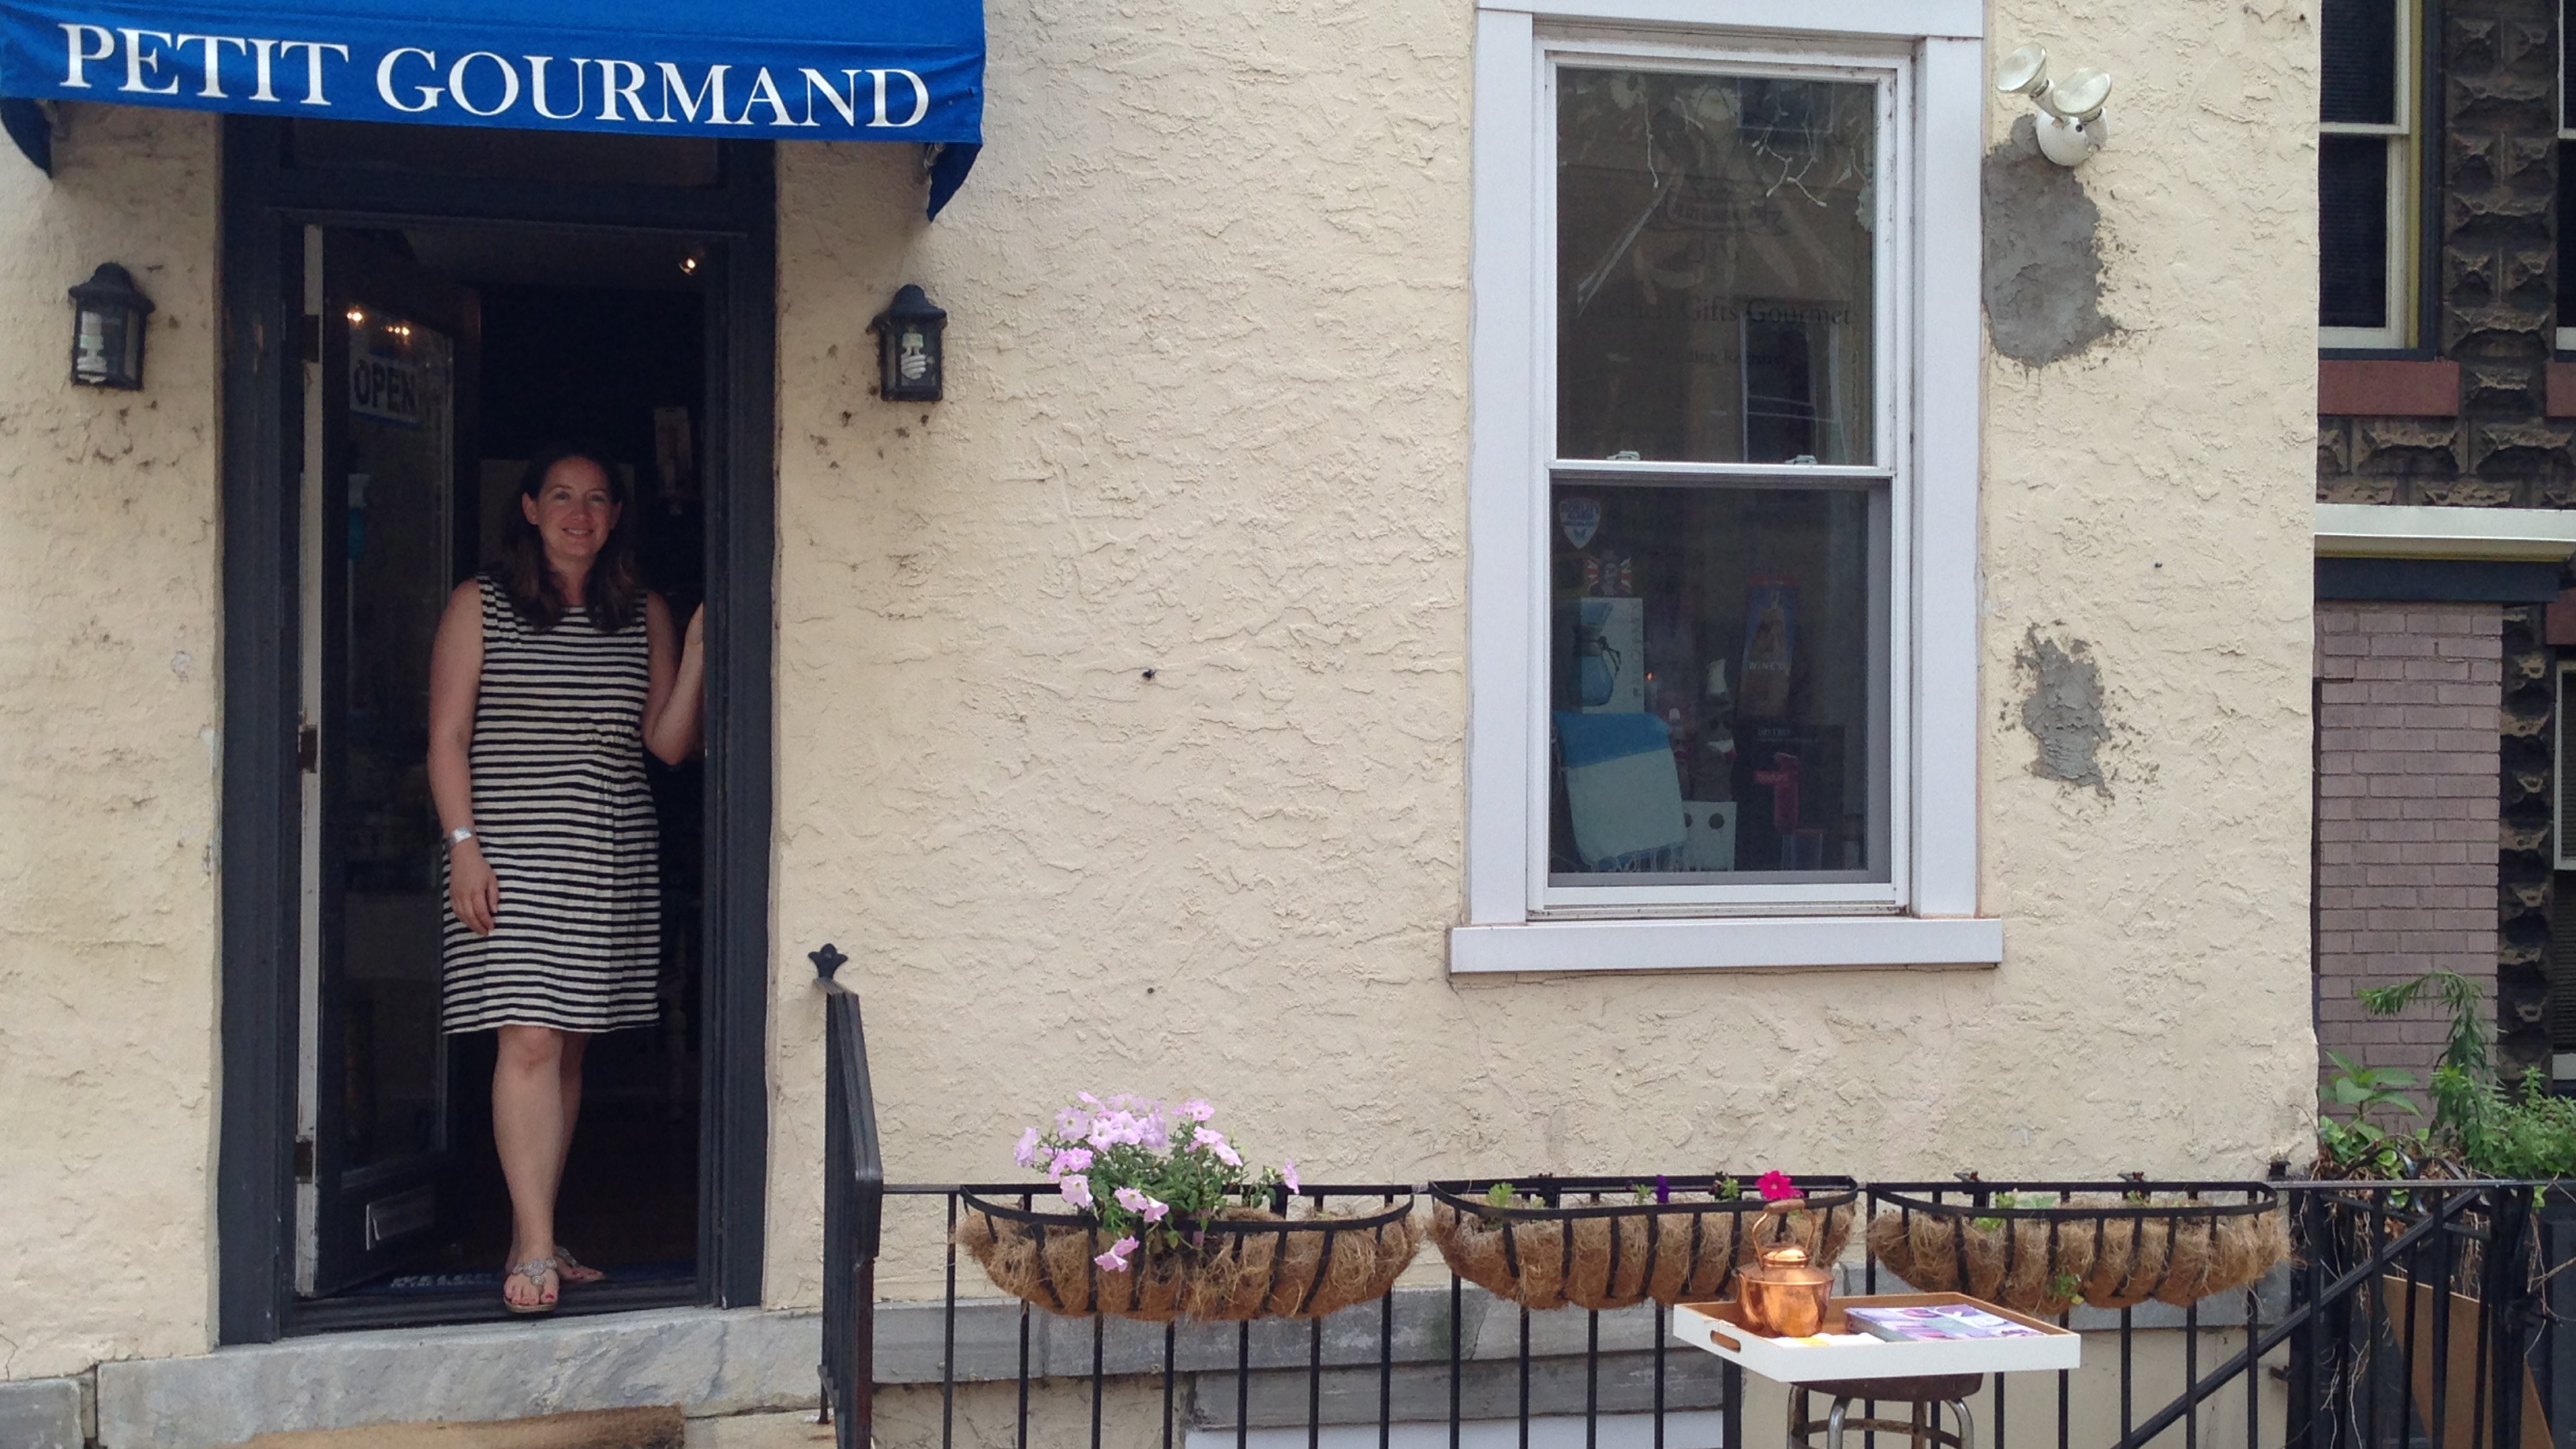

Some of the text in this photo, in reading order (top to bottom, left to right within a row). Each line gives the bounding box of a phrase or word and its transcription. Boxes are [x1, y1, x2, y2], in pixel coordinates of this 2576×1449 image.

[58, 21, 931, 129] PETIT GOURMAND
[1746, 297, 1852, 325] Gourmet
[354, 359, 417, 415] OPEN
